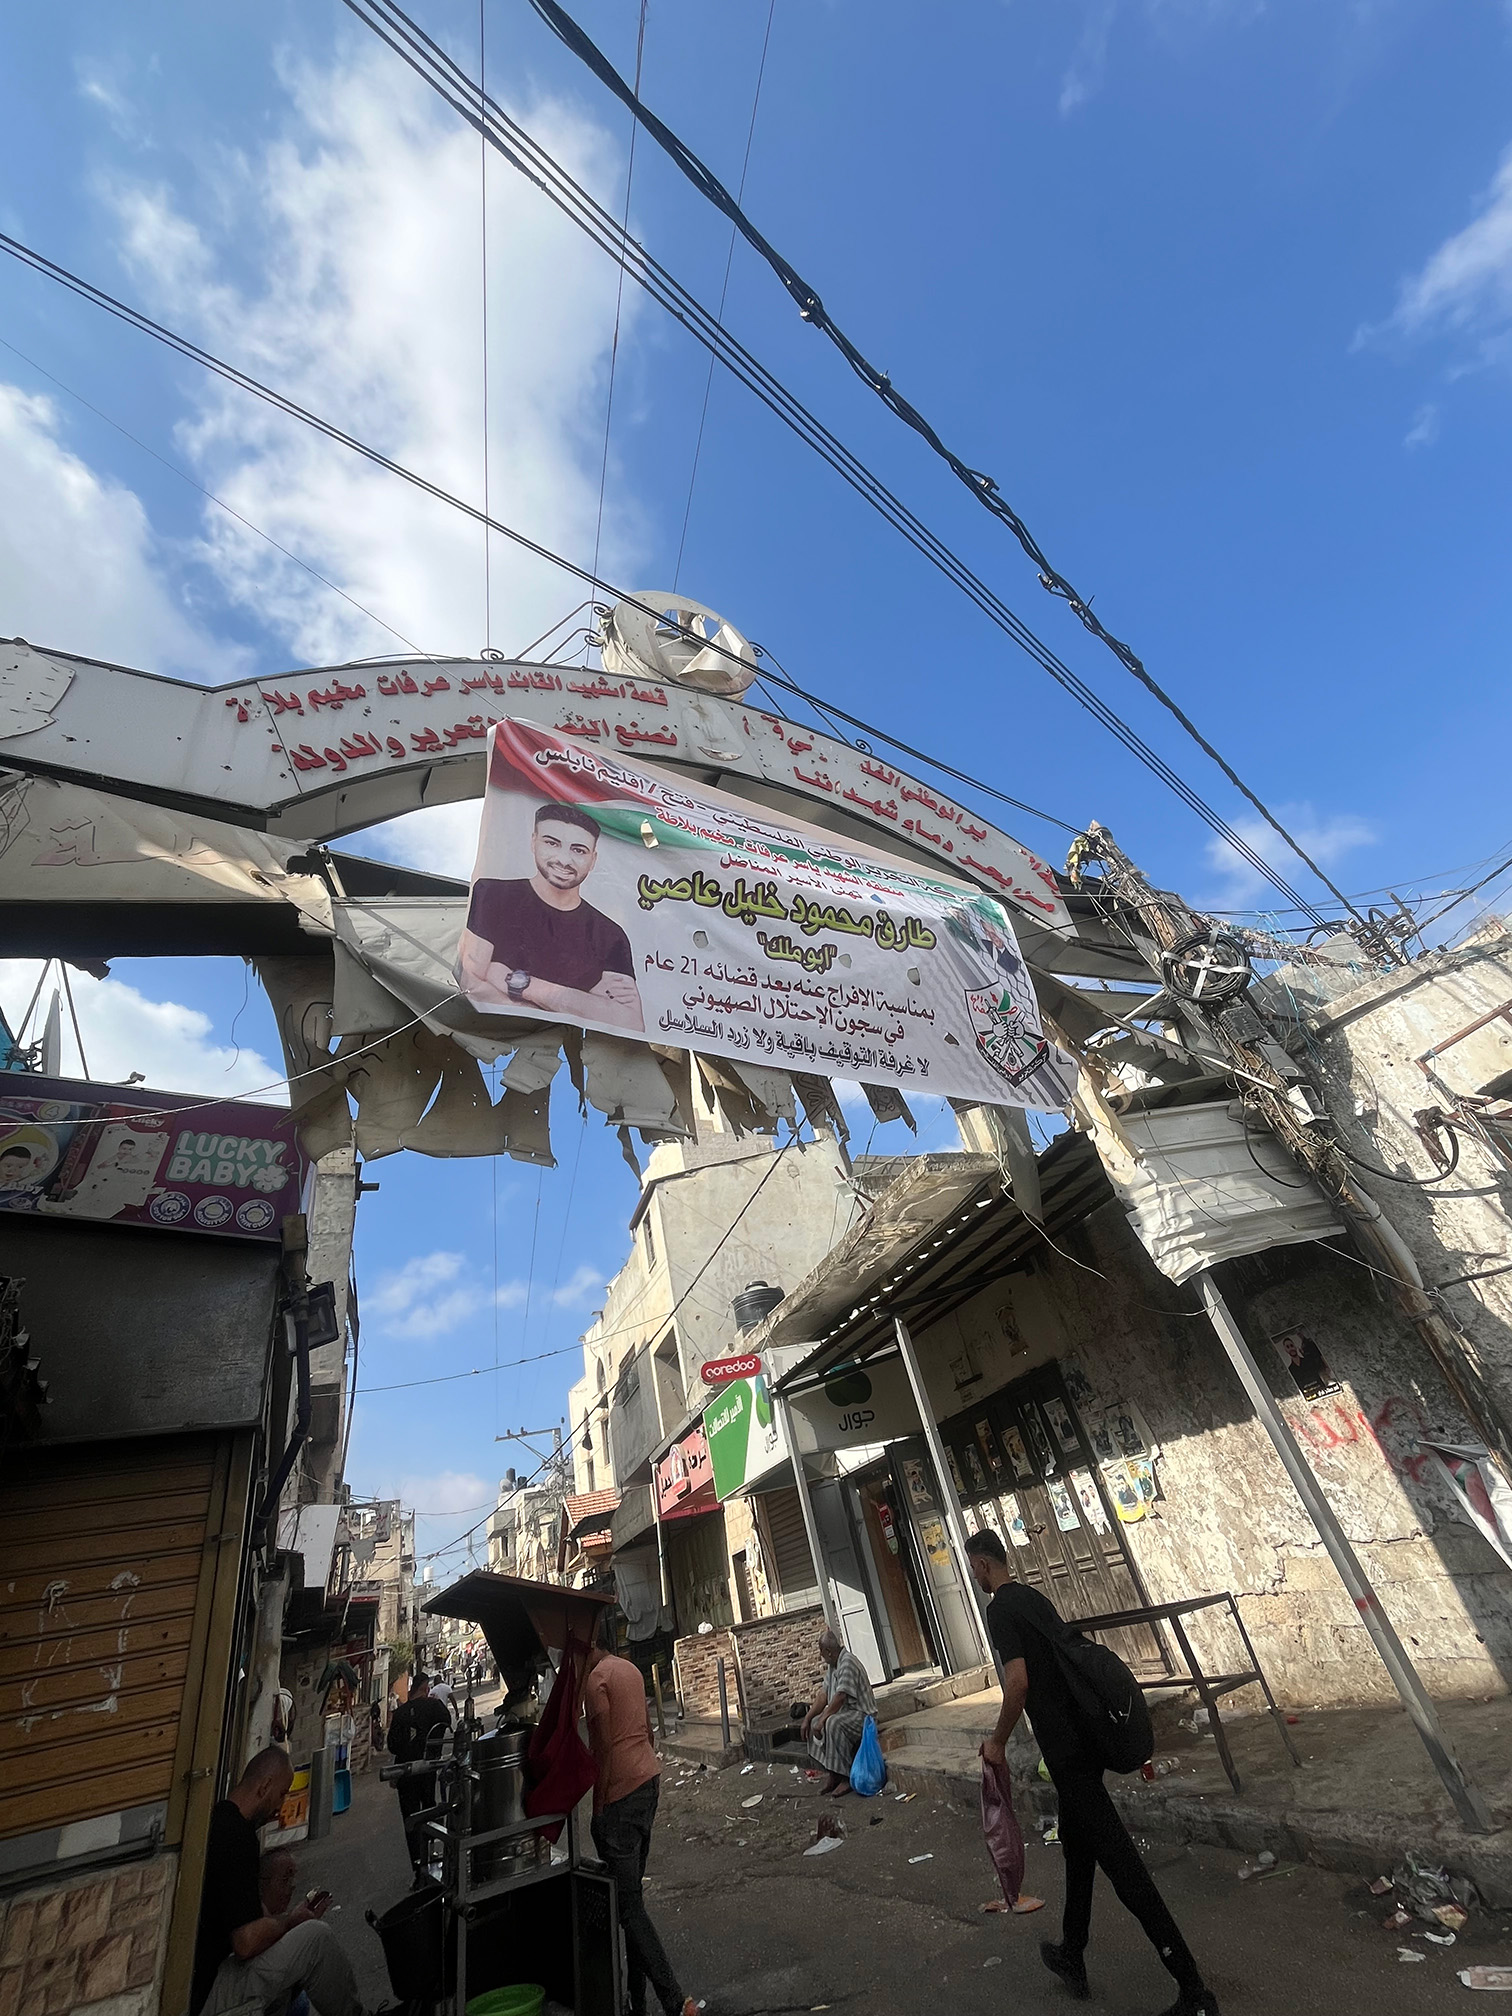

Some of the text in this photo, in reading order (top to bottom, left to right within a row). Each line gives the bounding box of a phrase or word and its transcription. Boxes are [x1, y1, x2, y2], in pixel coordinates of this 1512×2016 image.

[377, 669, 450, 696] عرفات
[459, 670, 504, 695] ياسر
[507, 670, 562, 691] القائد
[625, 680, 668, 706] قلعة
[225, 690, 304, 722] بلاة
[308, 679, 366, 712] مخيم
[552, 715, 610, 737] النص
[614, 720, 678, 747] نصنع
[535, 748, 596, 773] نابلس
[598, 766, 645, 793] إقليم
[660, 789, 696, 810] فتح
[900, 785, 964, 825] الوطني
[656, 806, 698, 837] بلاطة
[712, 812, 805, 850] الفلسطيني
[699, 827, 735, 846] مخيم
[901, 819, 954, 853] دماء
[719, 852, 783, 877] المناضل
[792, 859, 822, 878] ياسر
[807, 847, 861, 870] الوطني
[823, 867, 864, 887] الشهيد
[865, 864, 920, 887] التحرير
[865, 878, 905, 898] منطقة
[637, 870, 938, 952] طارق محمود خليل عاصي
[644, 951, 936, 1026] بمناسبة الإفراج عنه بعد قضائه 21 عام
[681, 986, 905, 1047] في سجون الإحتلال الصهيوني
[658, 1009, 931, 1077] لا غرفة التوقيف باقية ولا زرد السلاسل
[177, 1132, 283, 1164] LUCKY
[168, 1156, 258, 1185] BABY
[705, 1358, 756, 1379] ooredoo
[838, 1410, 875, 1431] جوال
